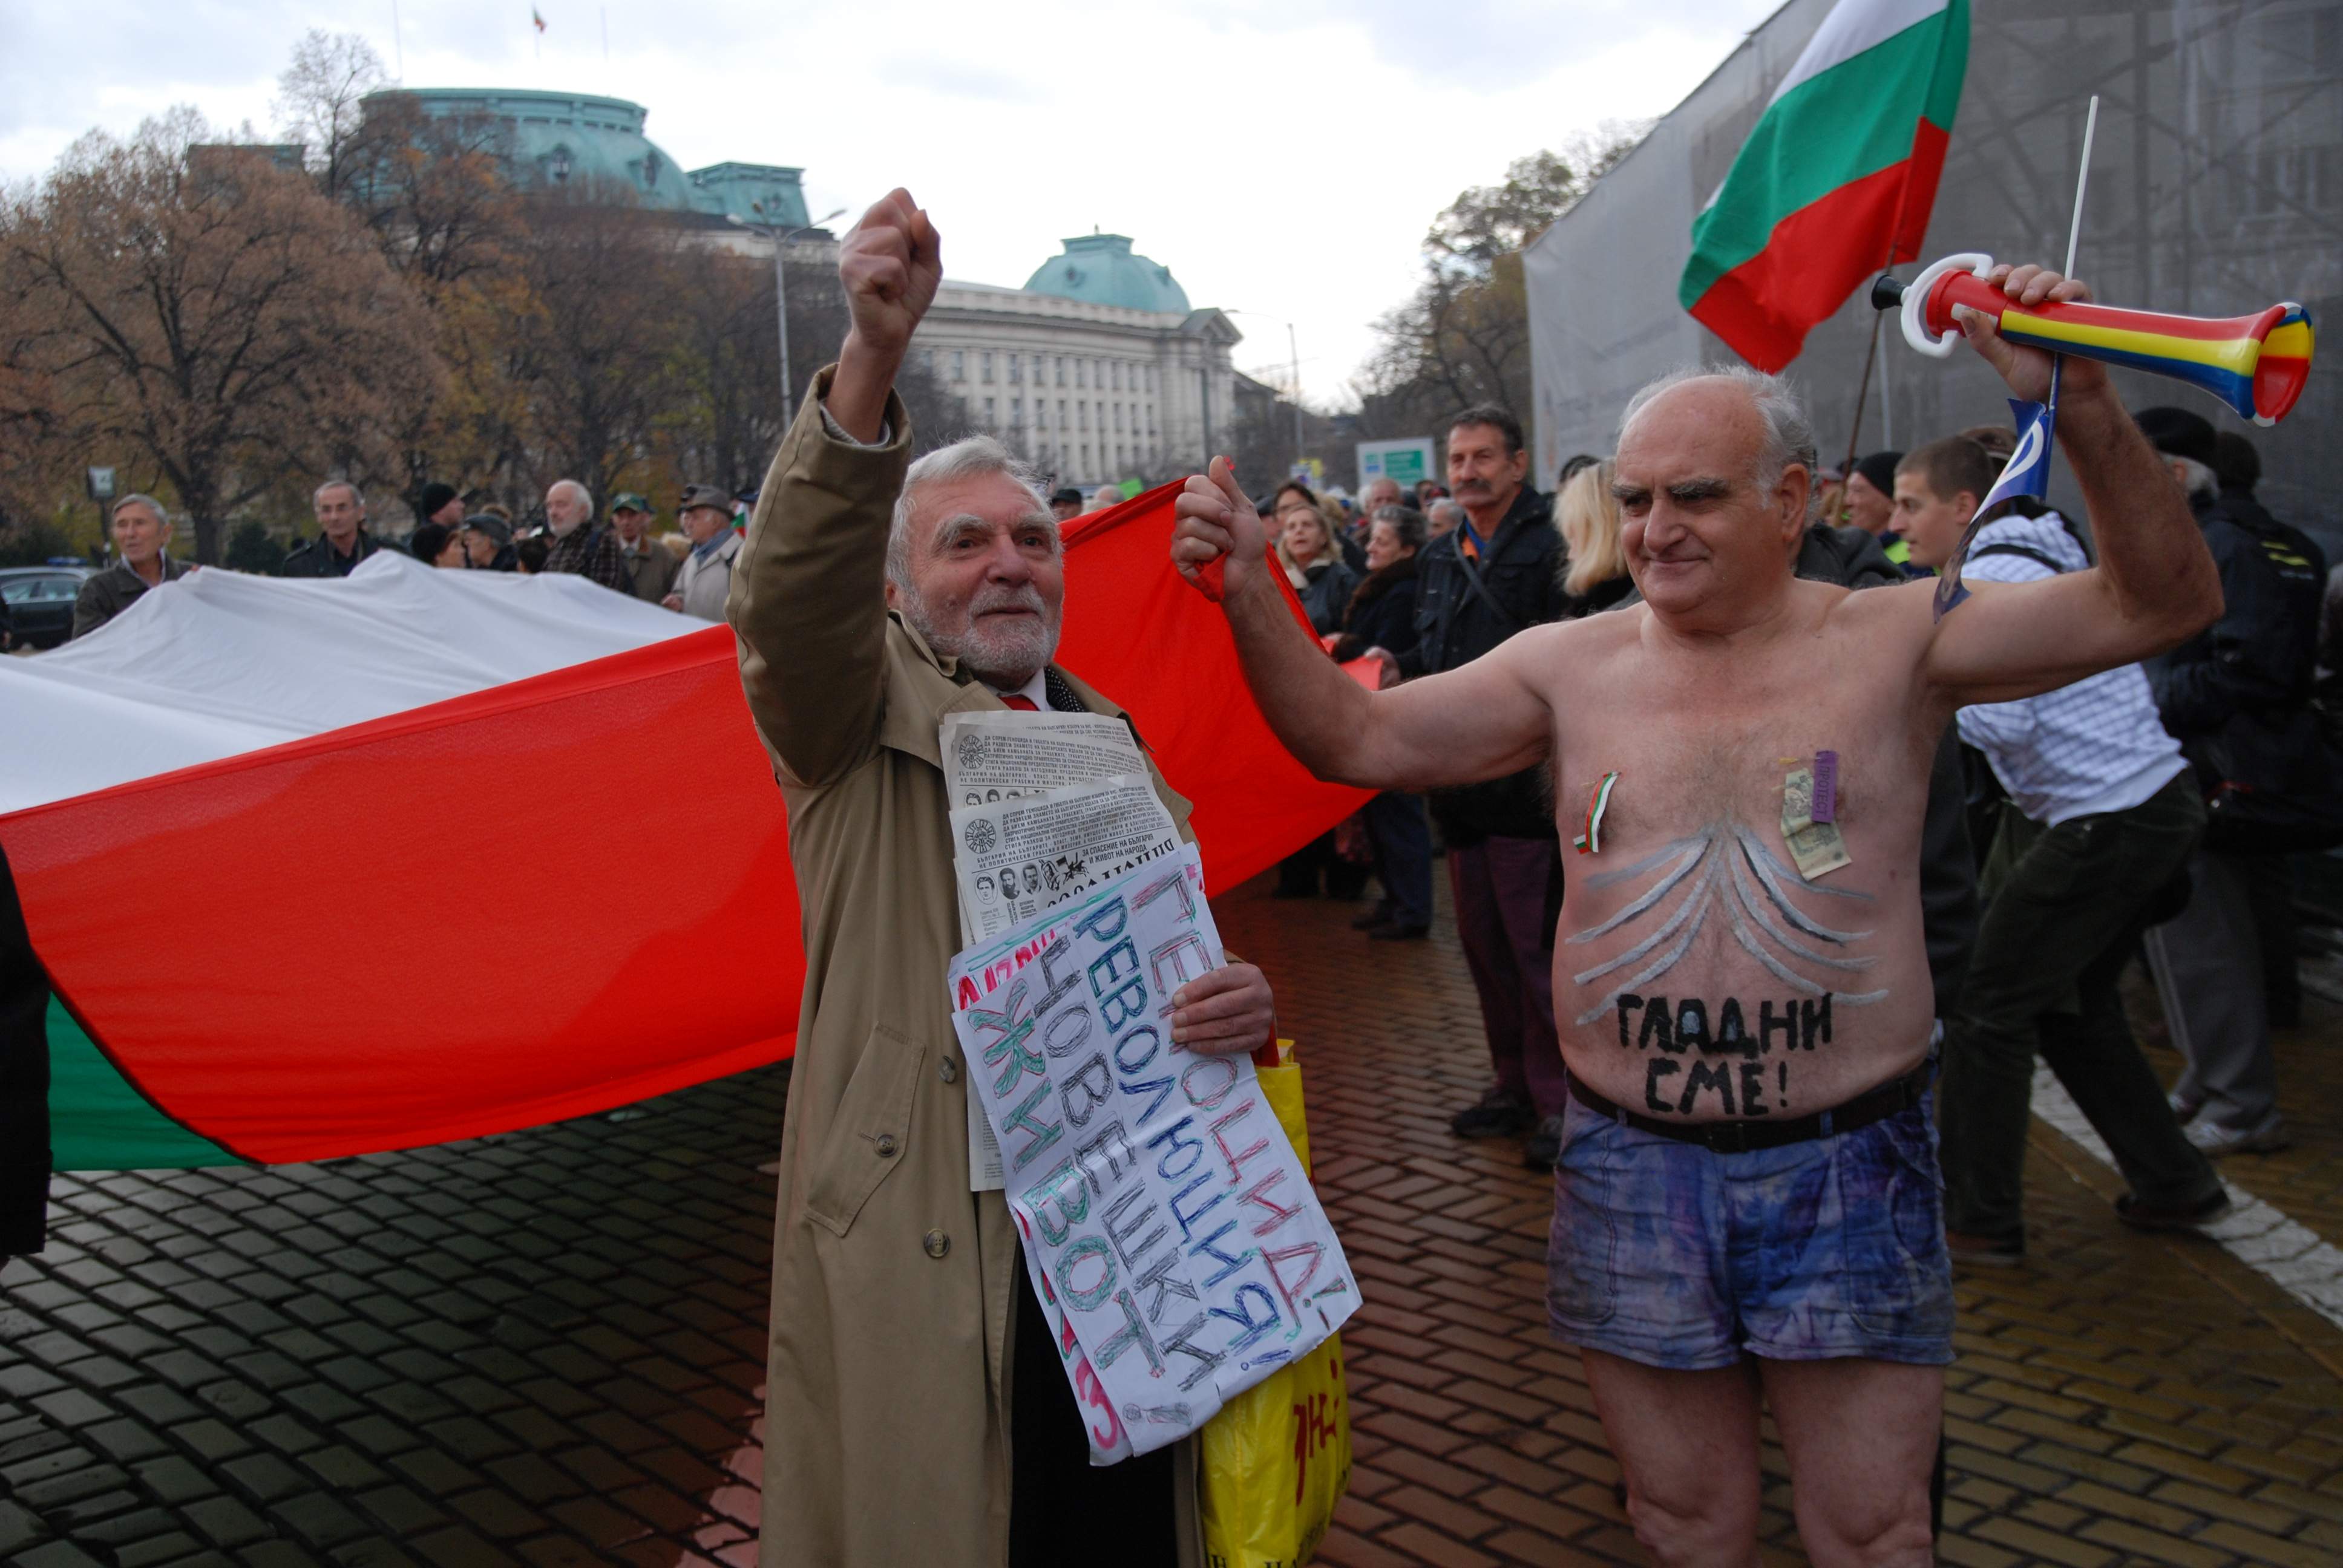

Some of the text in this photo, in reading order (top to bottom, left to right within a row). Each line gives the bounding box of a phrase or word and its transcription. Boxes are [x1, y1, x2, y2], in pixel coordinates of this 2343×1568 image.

[1815, 765, 1831, 817] ПРОТЕСТ
[977, 852, 1006, 863] БЪЛГАРИЯ
[989, 852, 1031, 866] ПОЛИТИЧЕСКИ
[1082, 833, 1154, 857] ЗА СПАСЕНИЕ НА БЪЛГАРИЯ
[1095, 851, 1115, 862] ЖИВОТ
[1115, 849, 1123, 858] НА
[1124, 843, 1147, 855] НАРОДА
[1617, 992, 1832, 1059] ГЛАДНИ
[1132, 869, 1347, 1344] ГЕОЦИД!
[1645, 1057, 1788, 1115] СМЕ!
[1073, 894, 1292, 1371] РЕВОЛЮЦИЯ!
[1034, 935, 1227, 1392] ЧОВЕШКИ
[968, 978, 1192, 1426] ЖИВОТ!
